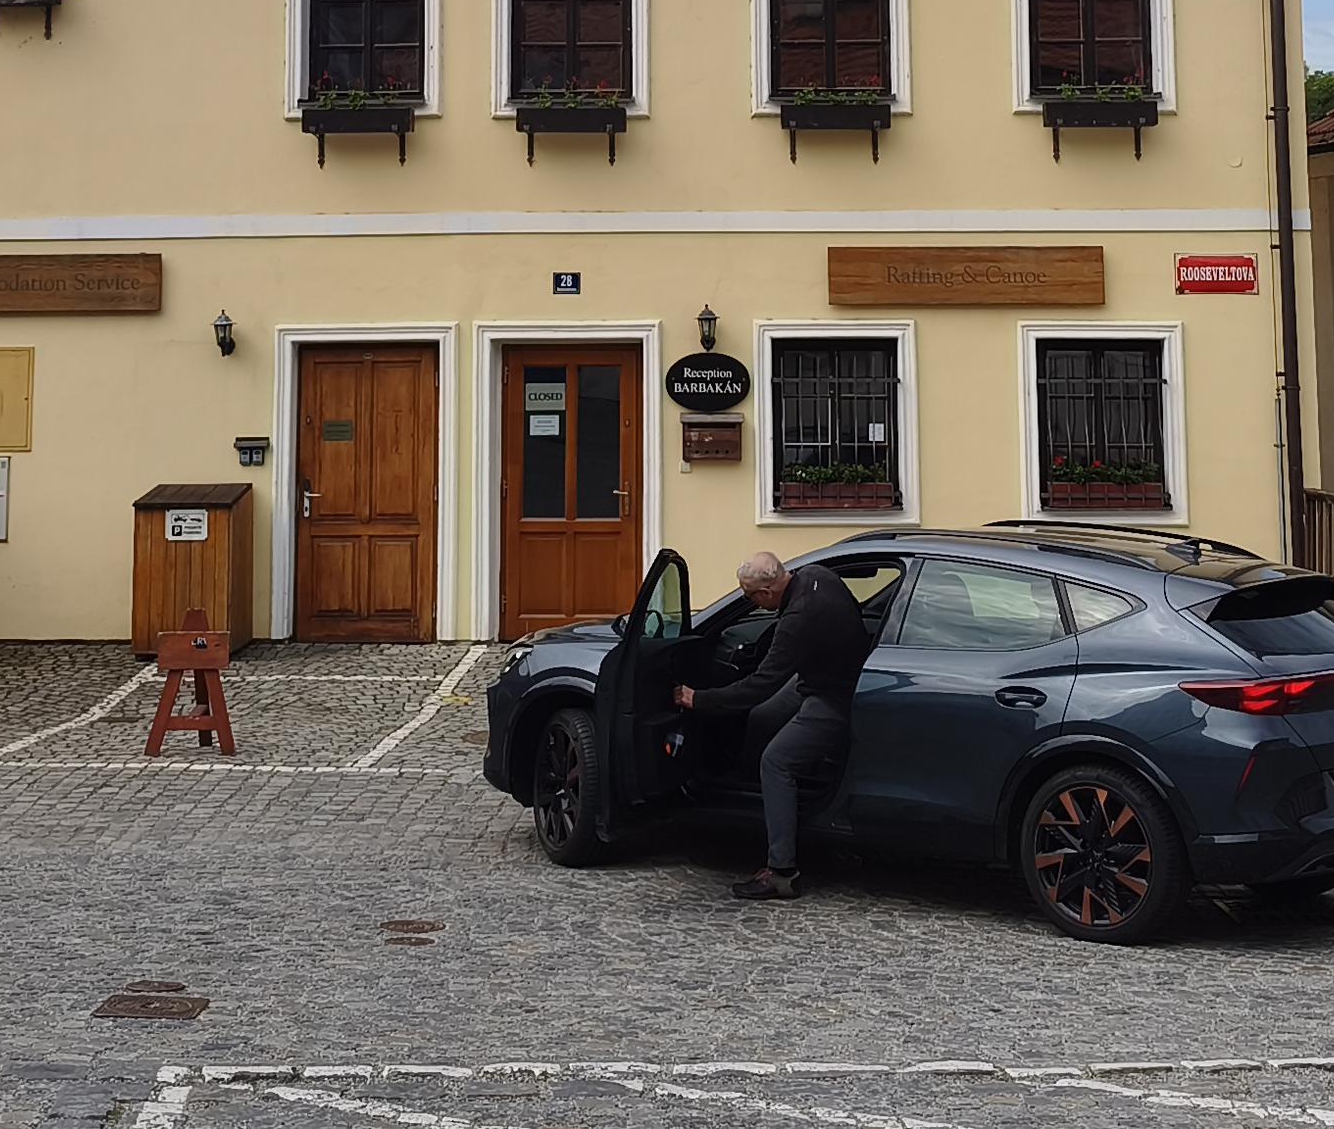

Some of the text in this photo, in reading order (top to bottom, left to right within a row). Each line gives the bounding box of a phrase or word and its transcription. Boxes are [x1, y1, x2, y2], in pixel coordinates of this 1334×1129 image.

[885, 265, 1048, 288] Rafting & Canoe
[1179, 266, 1255, 281] ROOSEVELTOVA
[74, 273, 141, 292] Service
[560, 274, 573, 287] 28
[683, 367, 733, 380] Reception
[673, 382, 742, 393] BARBAKÁN
[528, 392, 563, 401] CLOSED
